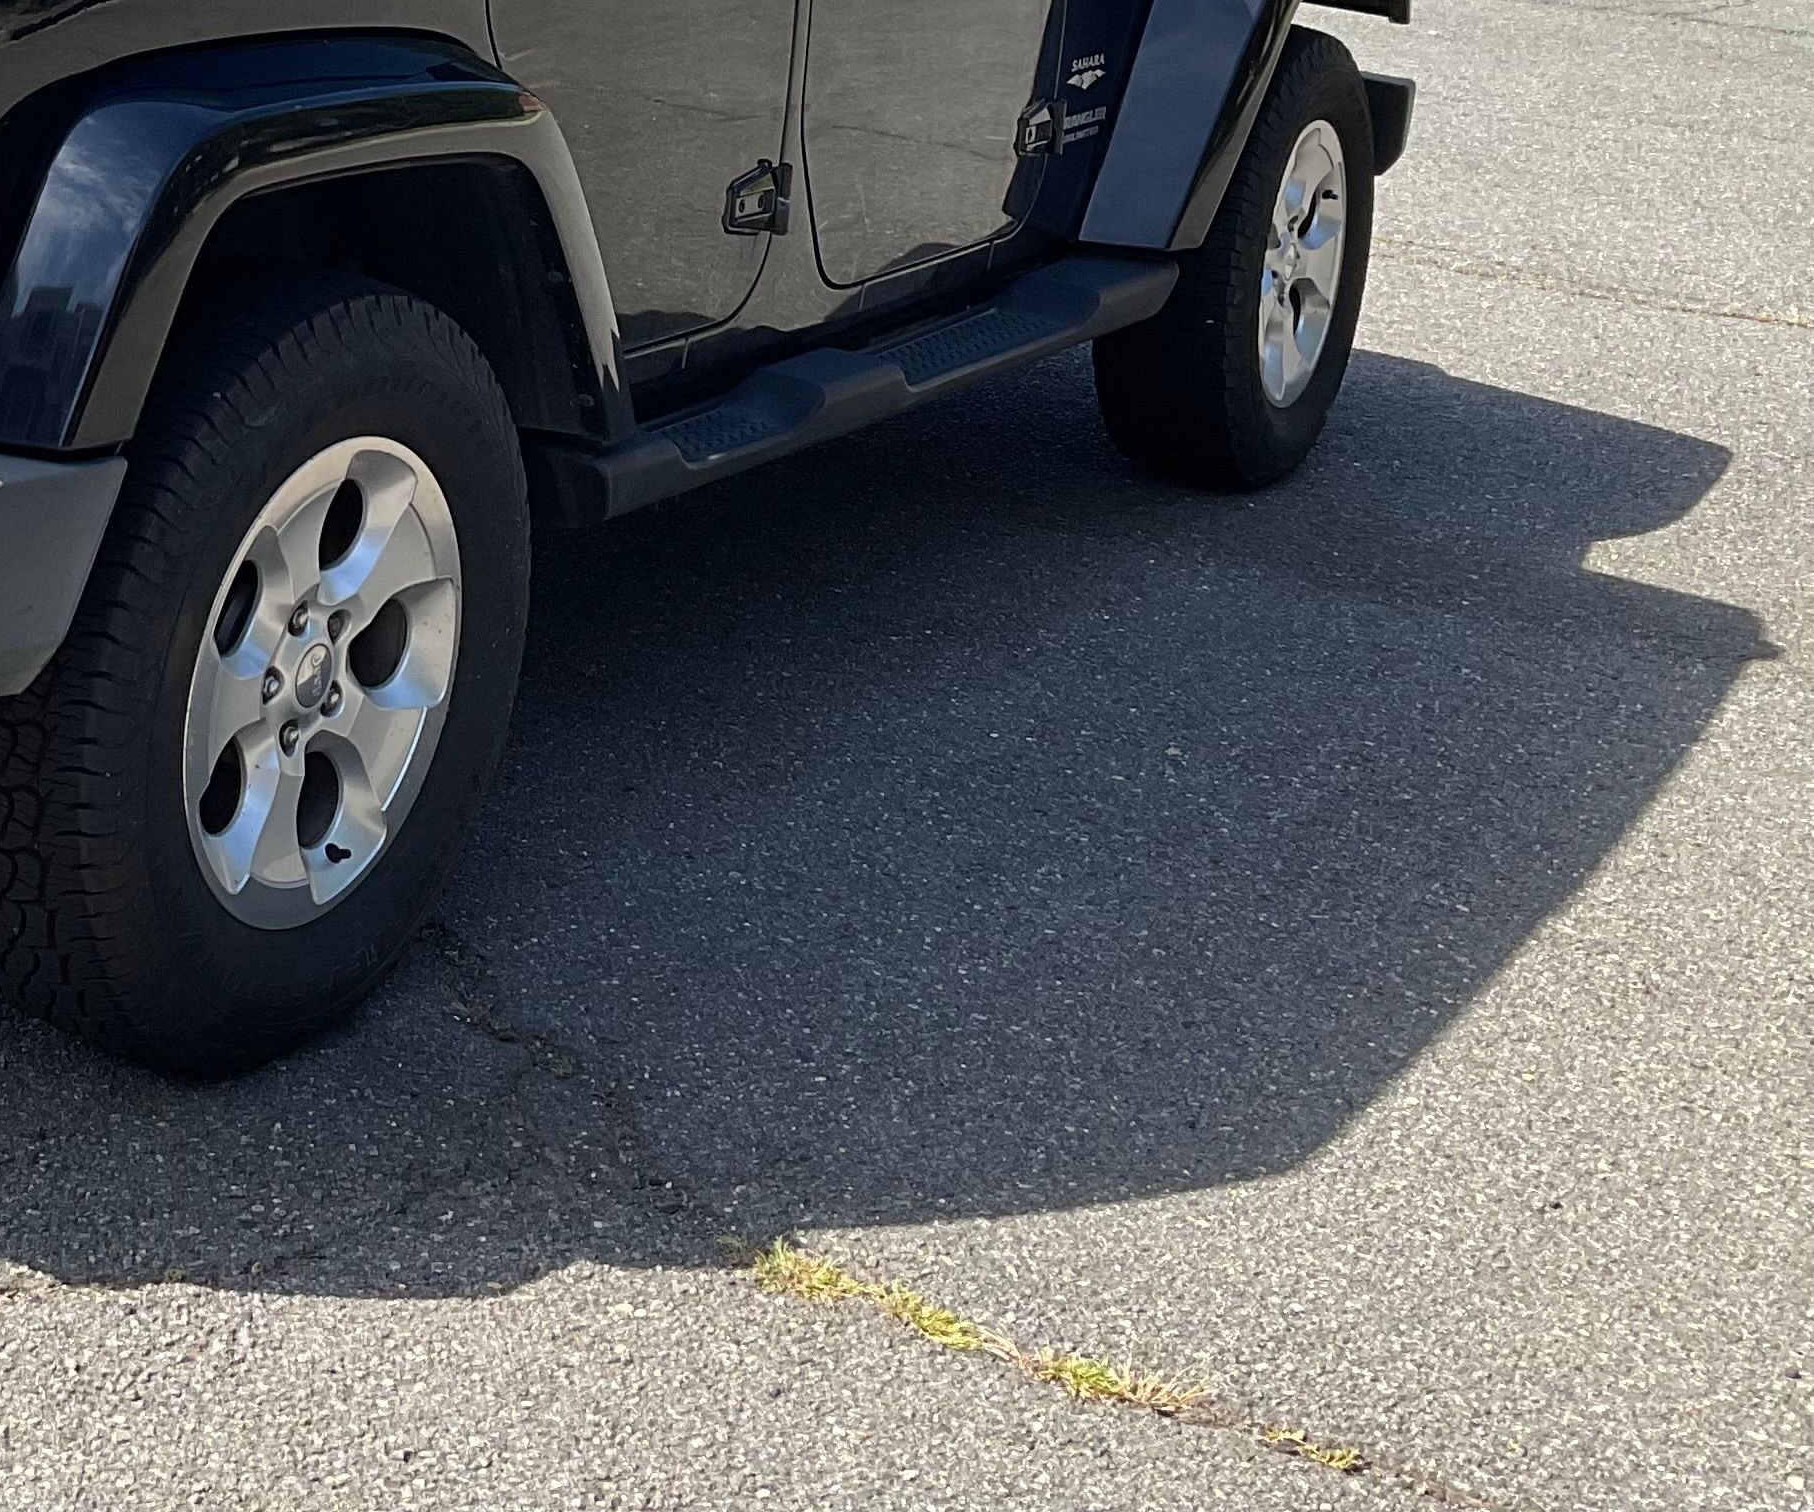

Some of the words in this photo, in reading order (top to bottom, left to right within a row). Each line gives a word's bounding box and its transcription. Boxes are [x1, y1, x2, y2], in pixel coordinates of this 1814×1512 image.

[1072, 53, 1105, 72] SAHARA
[1065, 106, 1106, 129] RANGLER
[1063, 125, 1099, 143] NLIMITED
